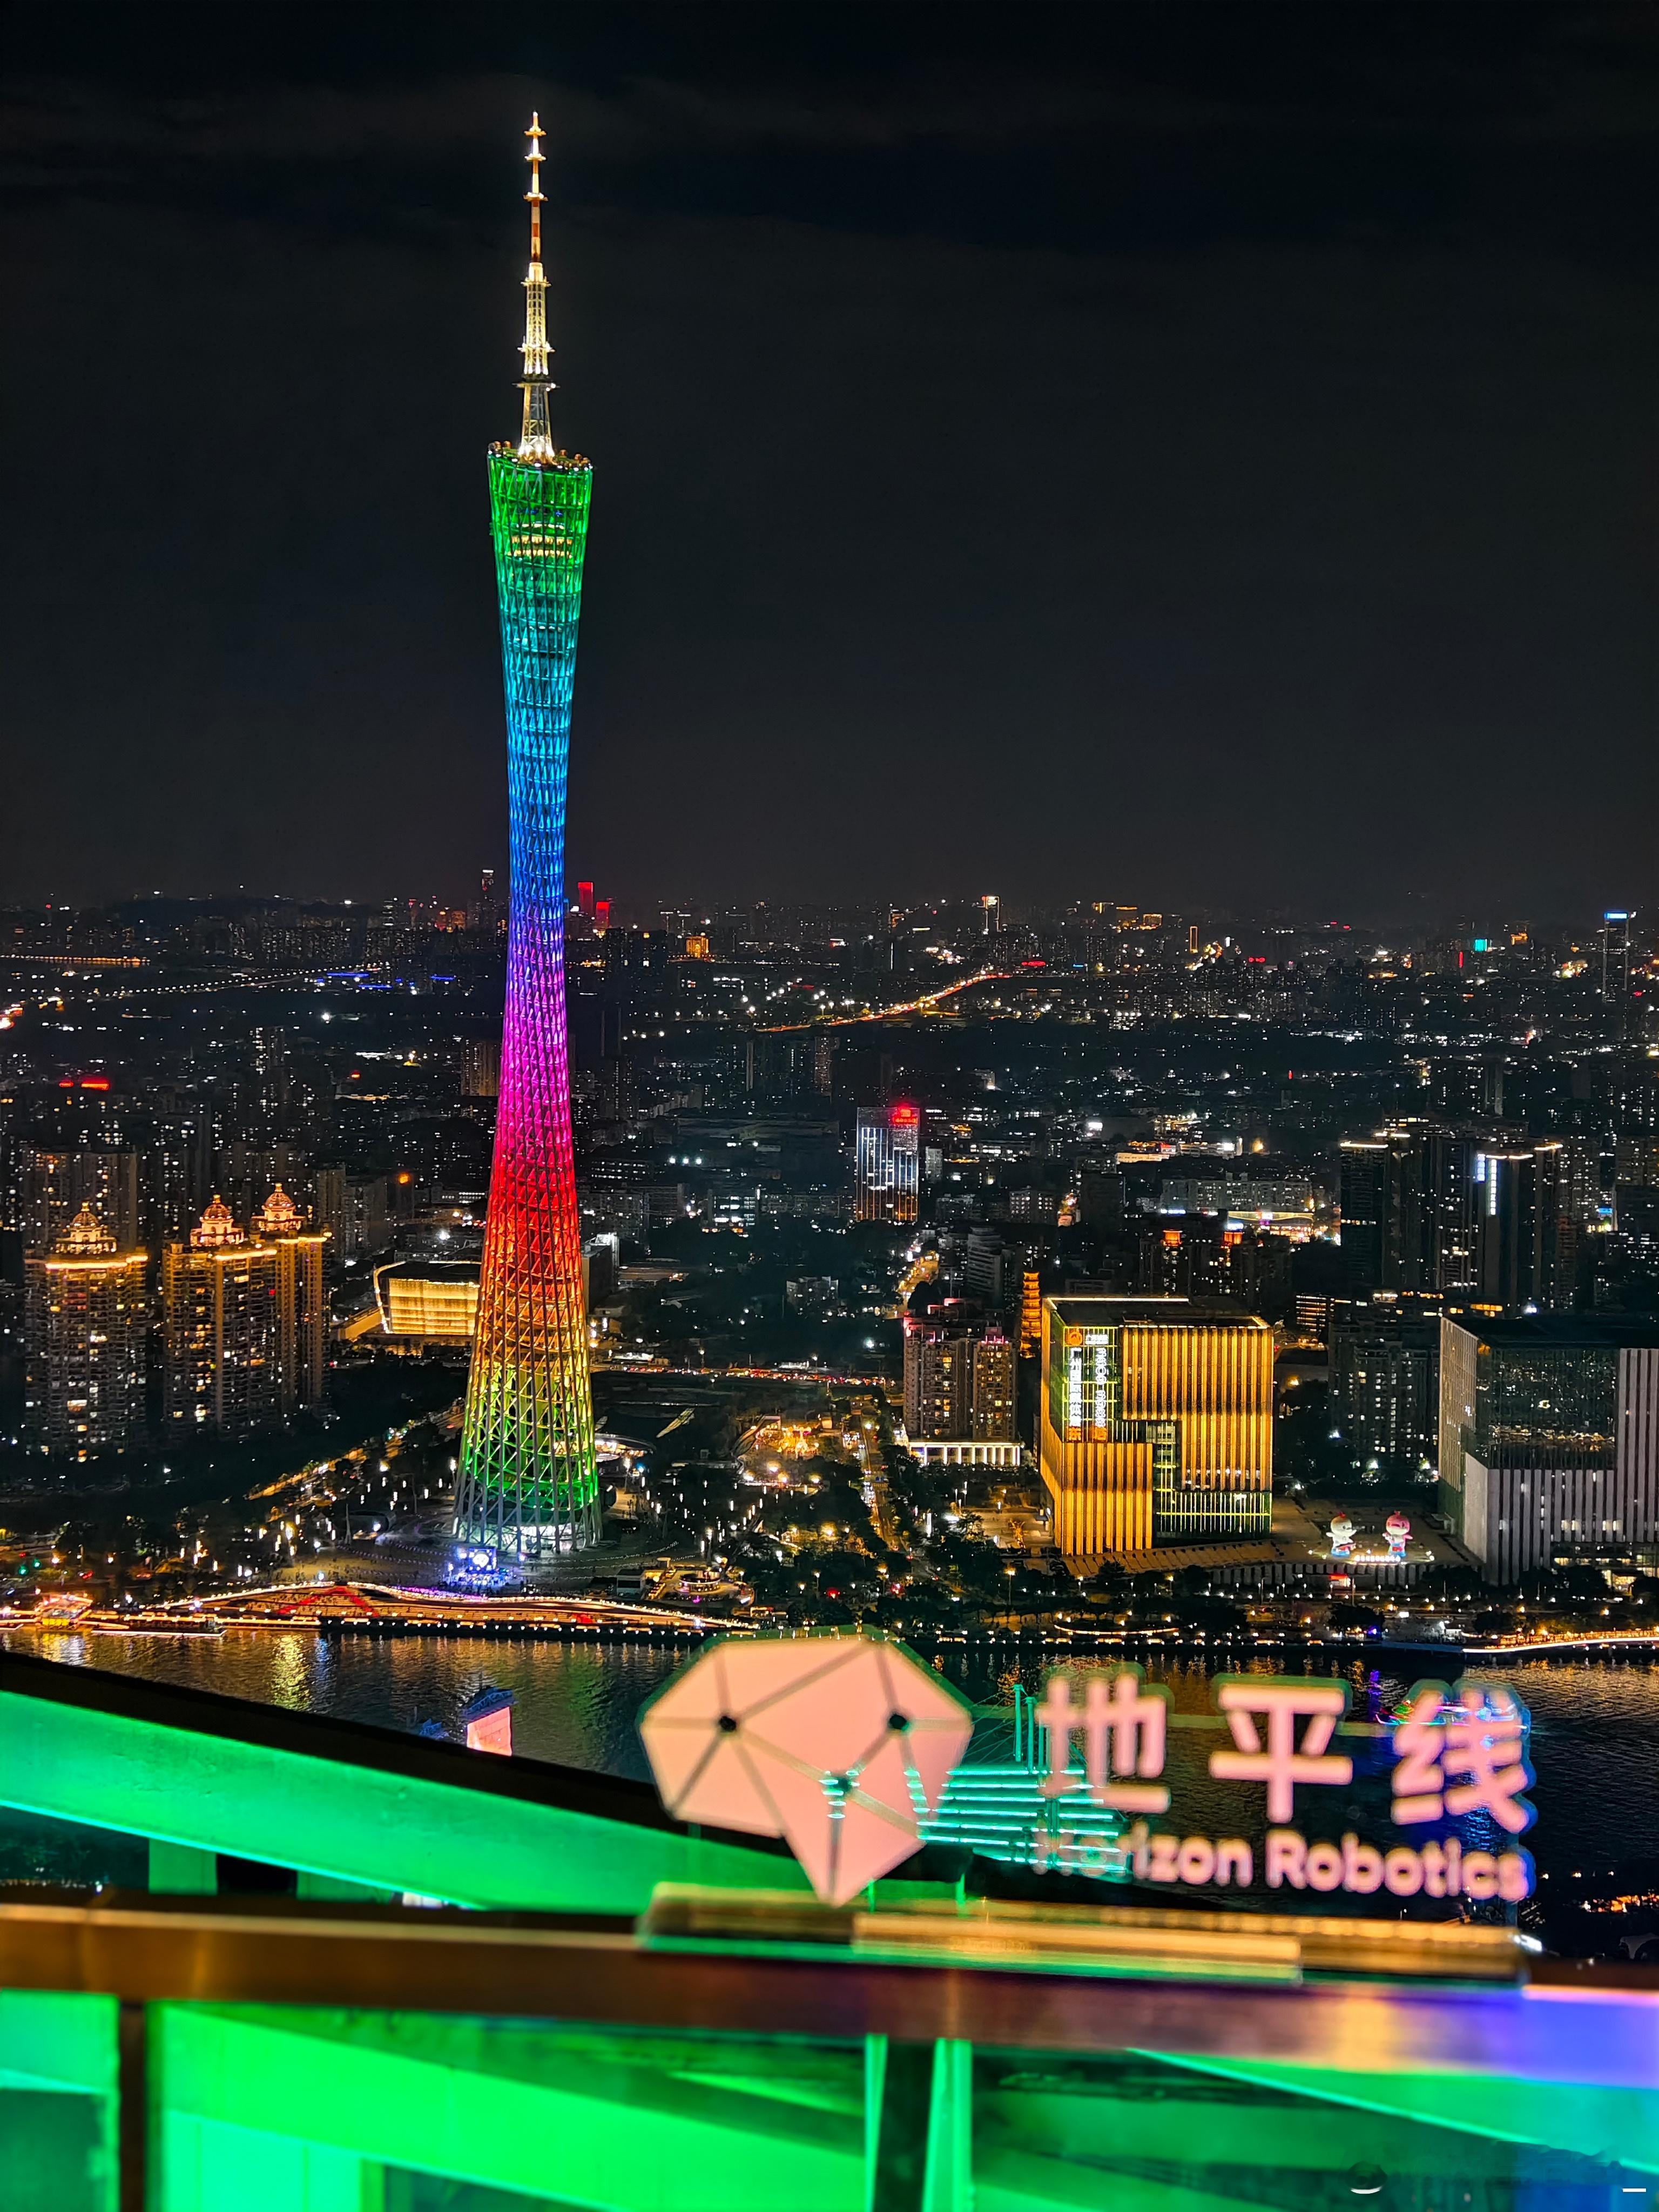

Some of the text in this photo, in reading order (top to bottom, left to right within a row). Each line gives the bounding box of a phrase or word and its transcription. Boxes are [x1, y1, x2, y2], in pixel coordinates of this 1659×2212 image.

[1036, 1675, 1531, 1832] 地平线
[1265, 1829, 1530, 1900] Robotics
